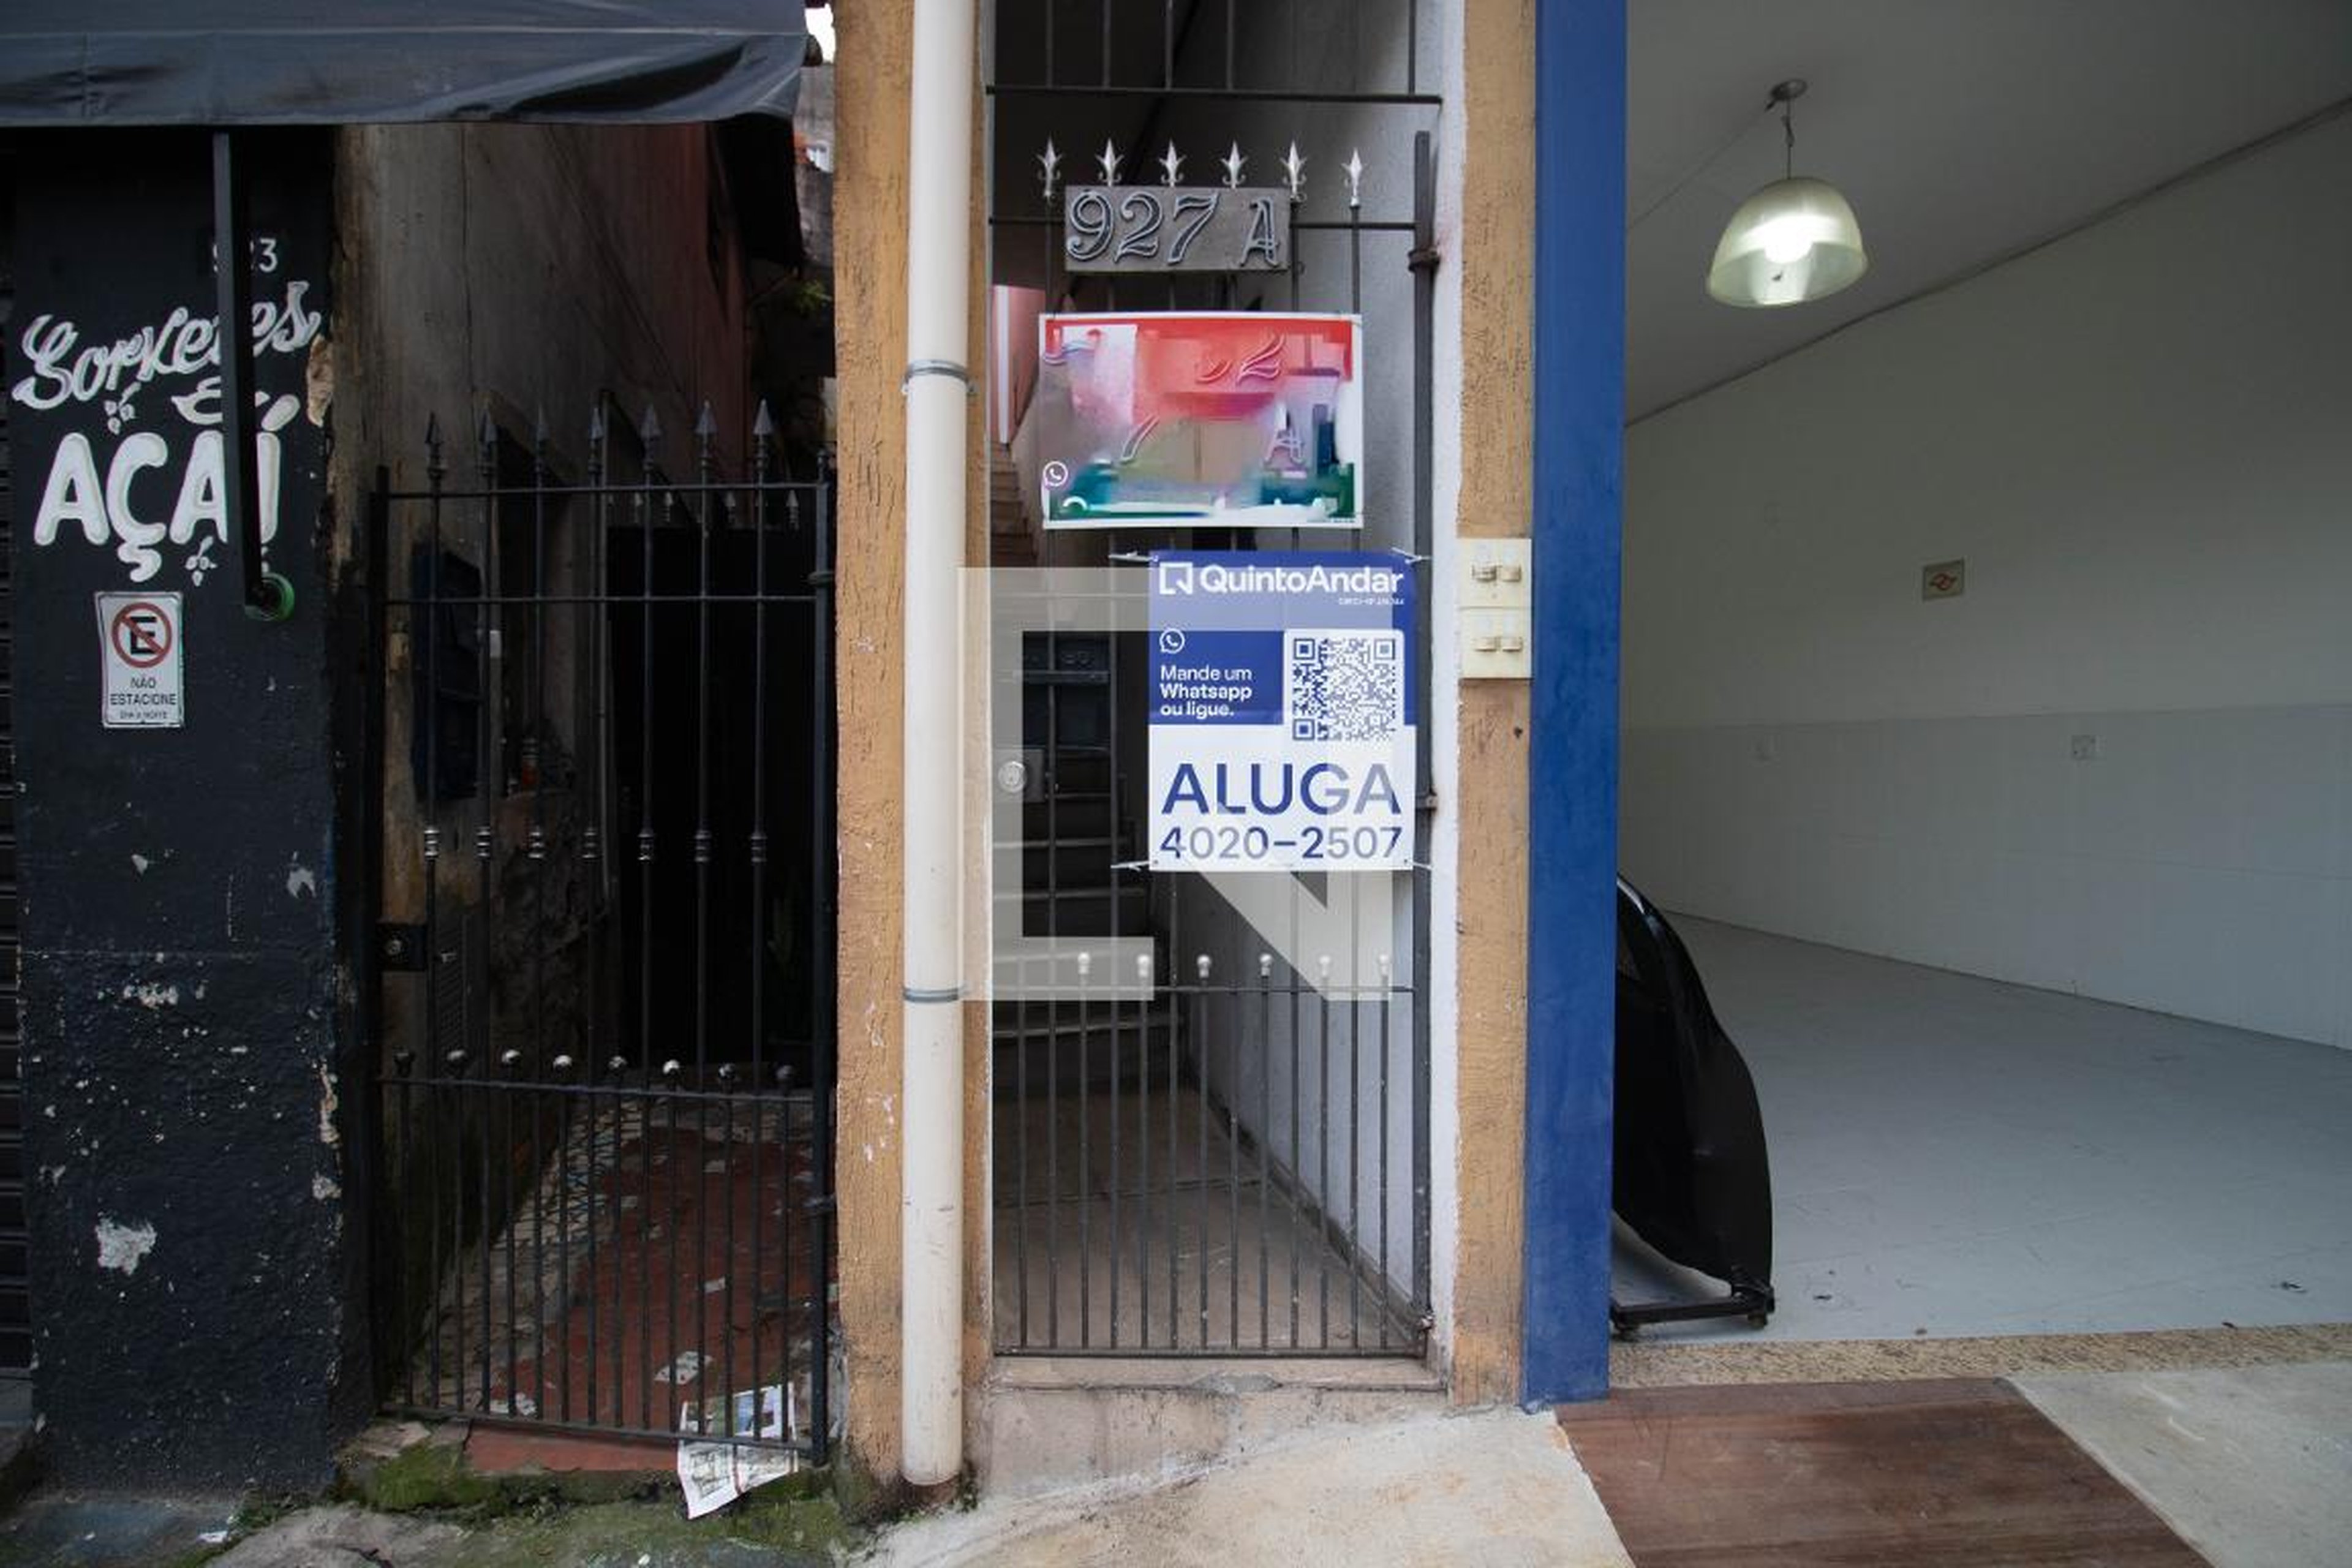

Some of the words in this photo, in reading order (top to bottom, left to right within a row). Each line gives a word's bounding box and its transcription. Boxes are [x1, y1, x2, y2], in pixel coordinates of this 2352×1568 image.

[1067, 190, 1219, 263] 927
[1239, 196, 1278, 267] A
[12, 280, 322, 410] Sorvees
[33, 394, 301, 582] AÇAÍ
[1199, 564, 1404, 595] QuintoAndar
[1160, 664, 1221, 680] Mande
[1224, 668, 1252, 680] um
[110, 693, 176, 705] ESTACIONE
[1159, 682, 1253, 702] Whatsapp
[1160, 704, 1183, 716] ou
[1186, 701, 1235, 720] ligue.
[1161, 762, 1401, 815] ALUGA
[1159, 826, 1403, 859] 4020-2507
